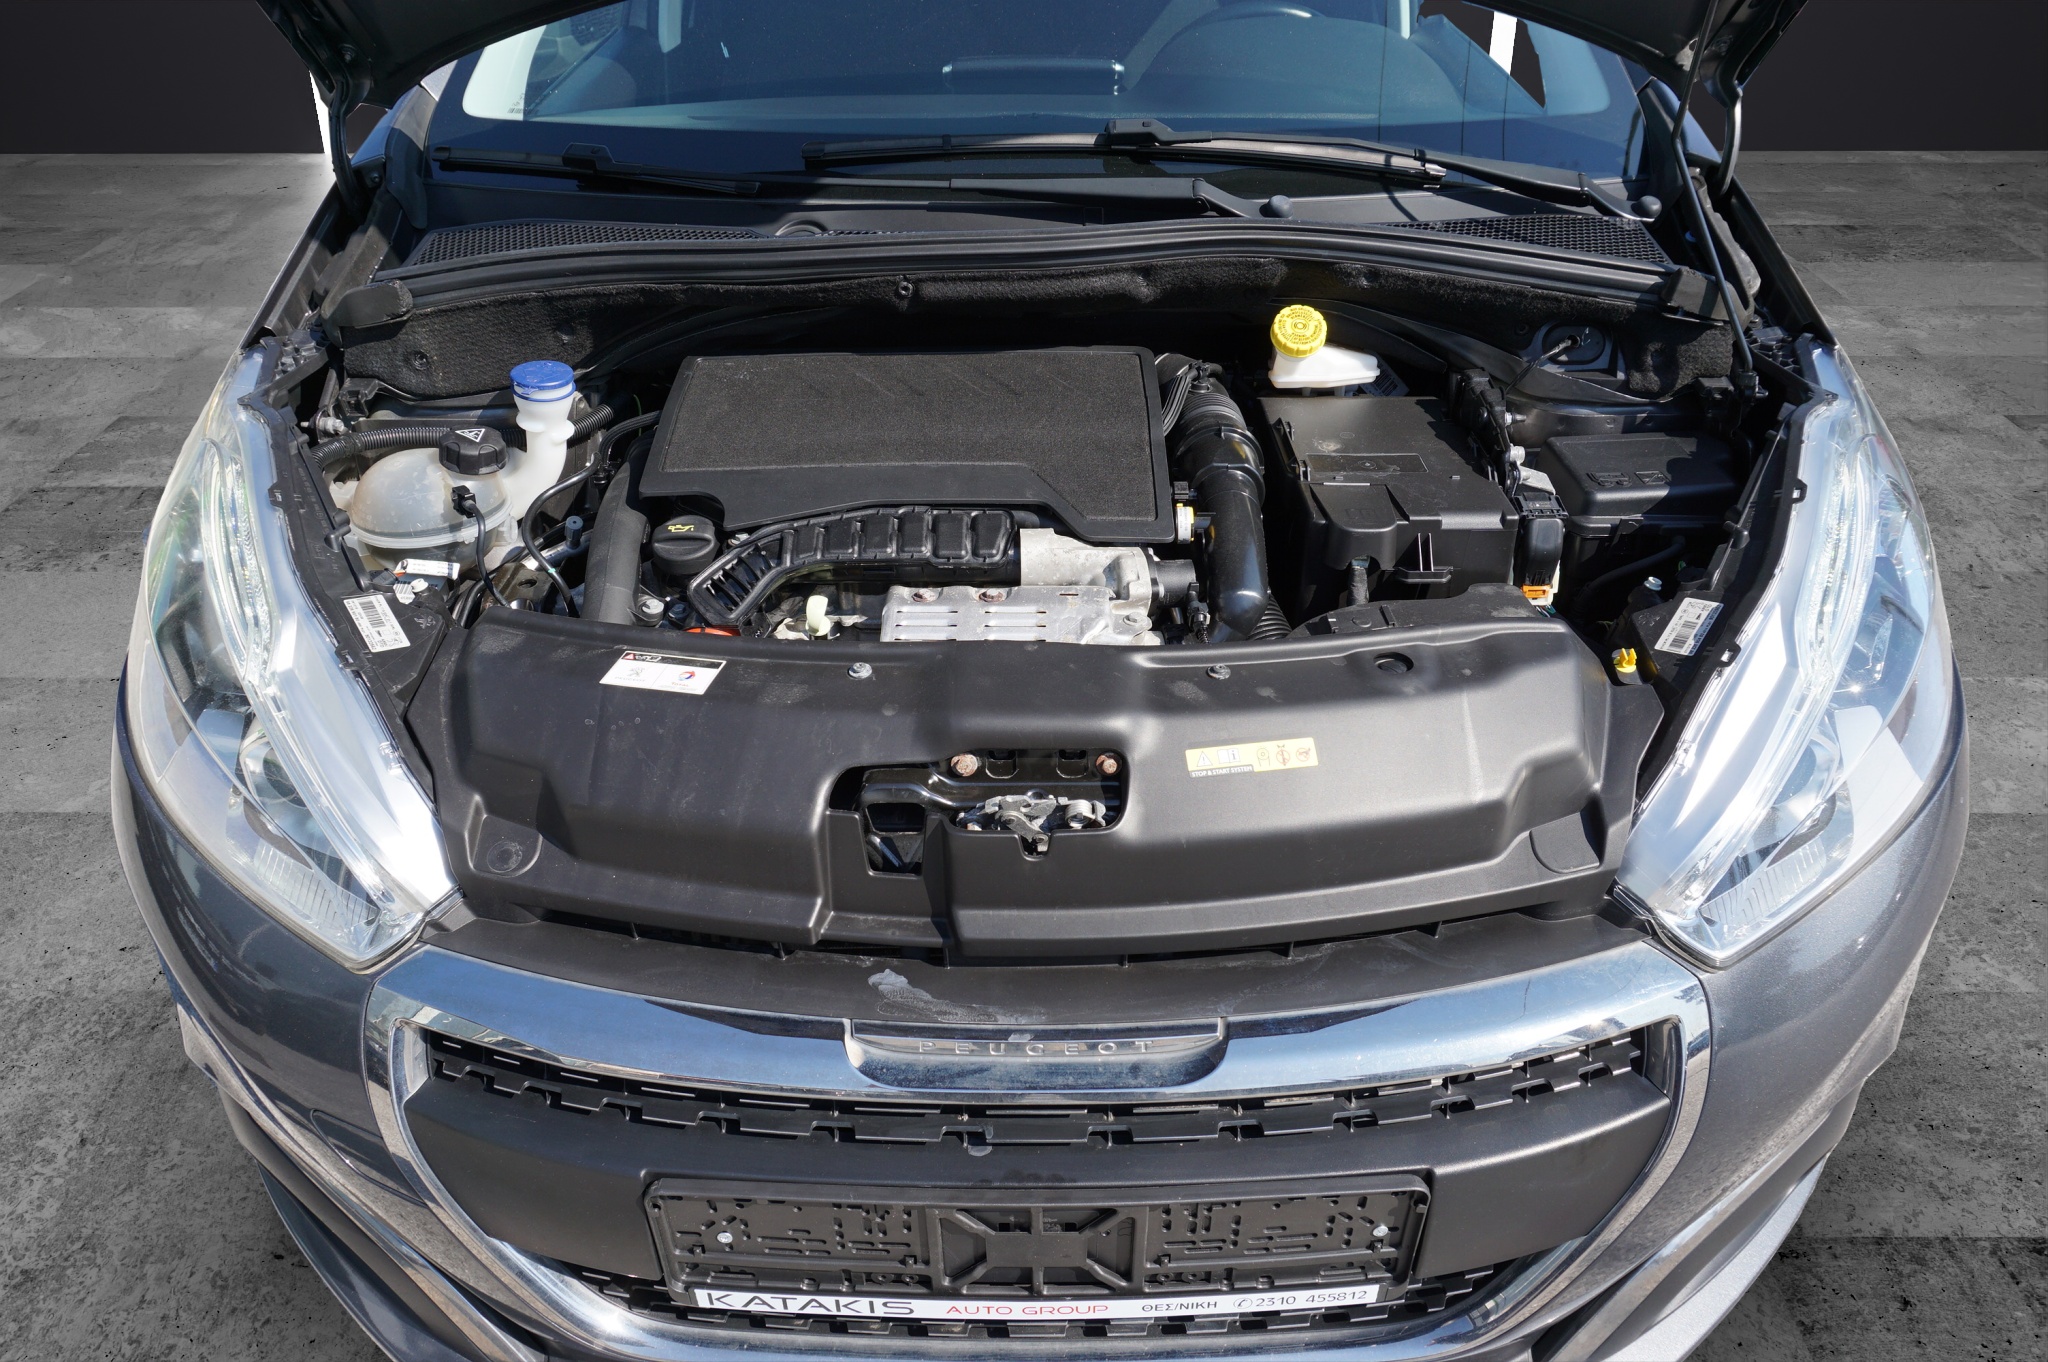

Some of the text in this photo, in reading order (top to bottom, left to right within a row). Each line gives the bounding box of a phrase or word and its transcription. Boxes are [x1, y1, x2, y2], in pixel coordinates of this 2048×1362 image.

[918, 1040, 1154, 1056] PEUGEOT
[706, 1292, 1109, 1316] KATAKIS AUTO GROUP
[1255, 1295, 1297, 1308] 2310
[1305, 1289, 1368, 1304] 455812
